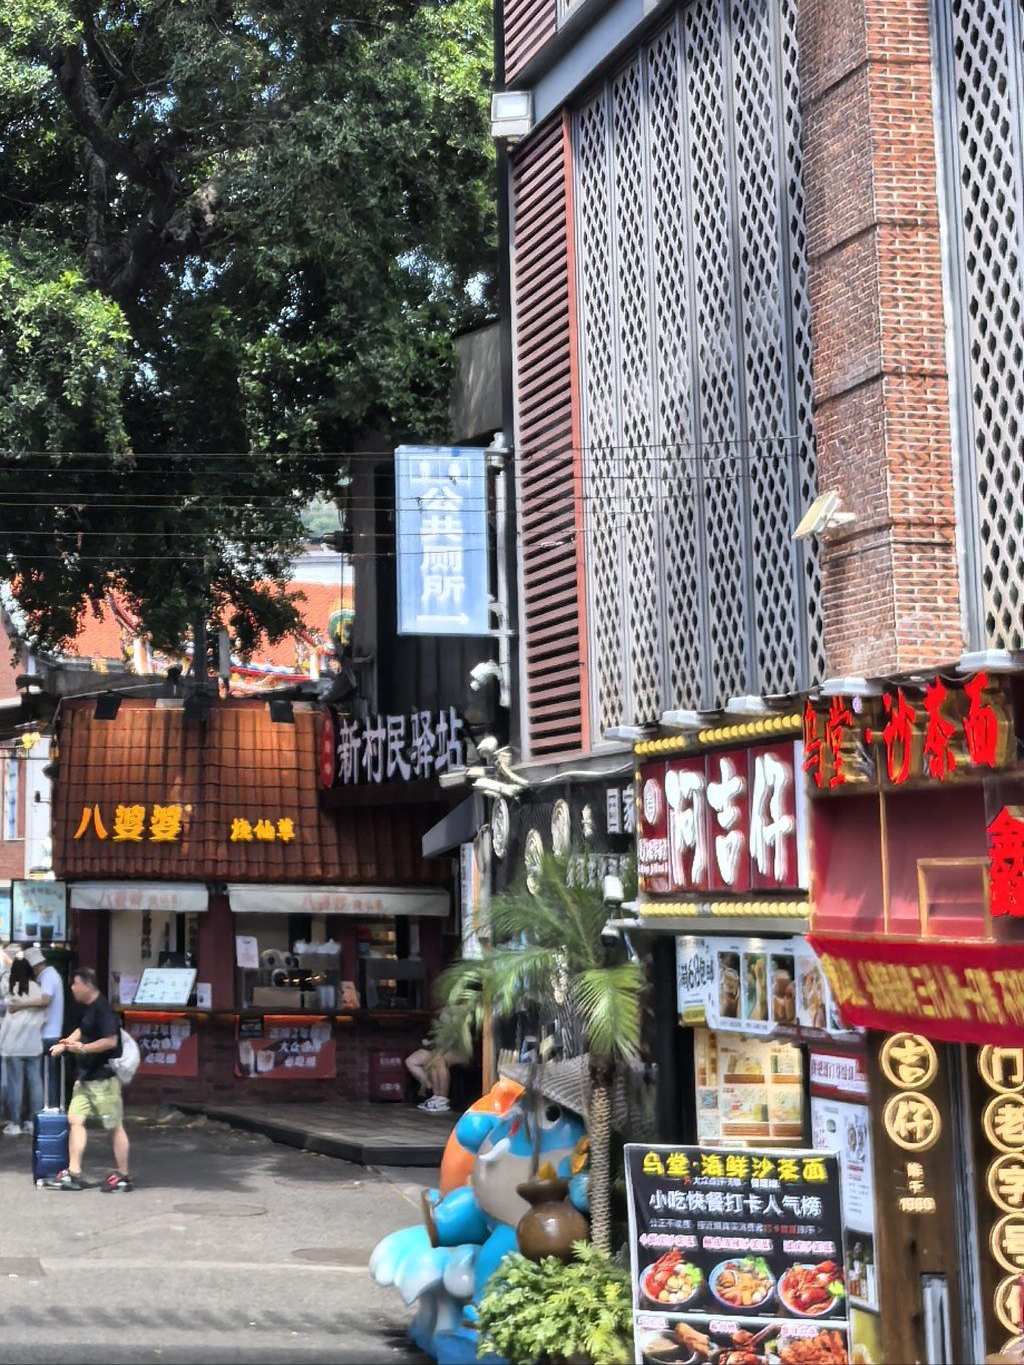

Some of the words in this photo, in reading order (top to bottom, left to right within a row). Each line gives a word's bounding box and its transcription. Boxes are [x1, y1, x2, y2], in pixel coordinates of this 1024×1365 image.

[420, 486, 466, 612] 公共厕所
[337, 705, 467, 784] 新村民驿站
[74, 803, 184, 842] 八婆婆
[649, 1190, 824, 1218] 小吃快餐打卡人气榜
